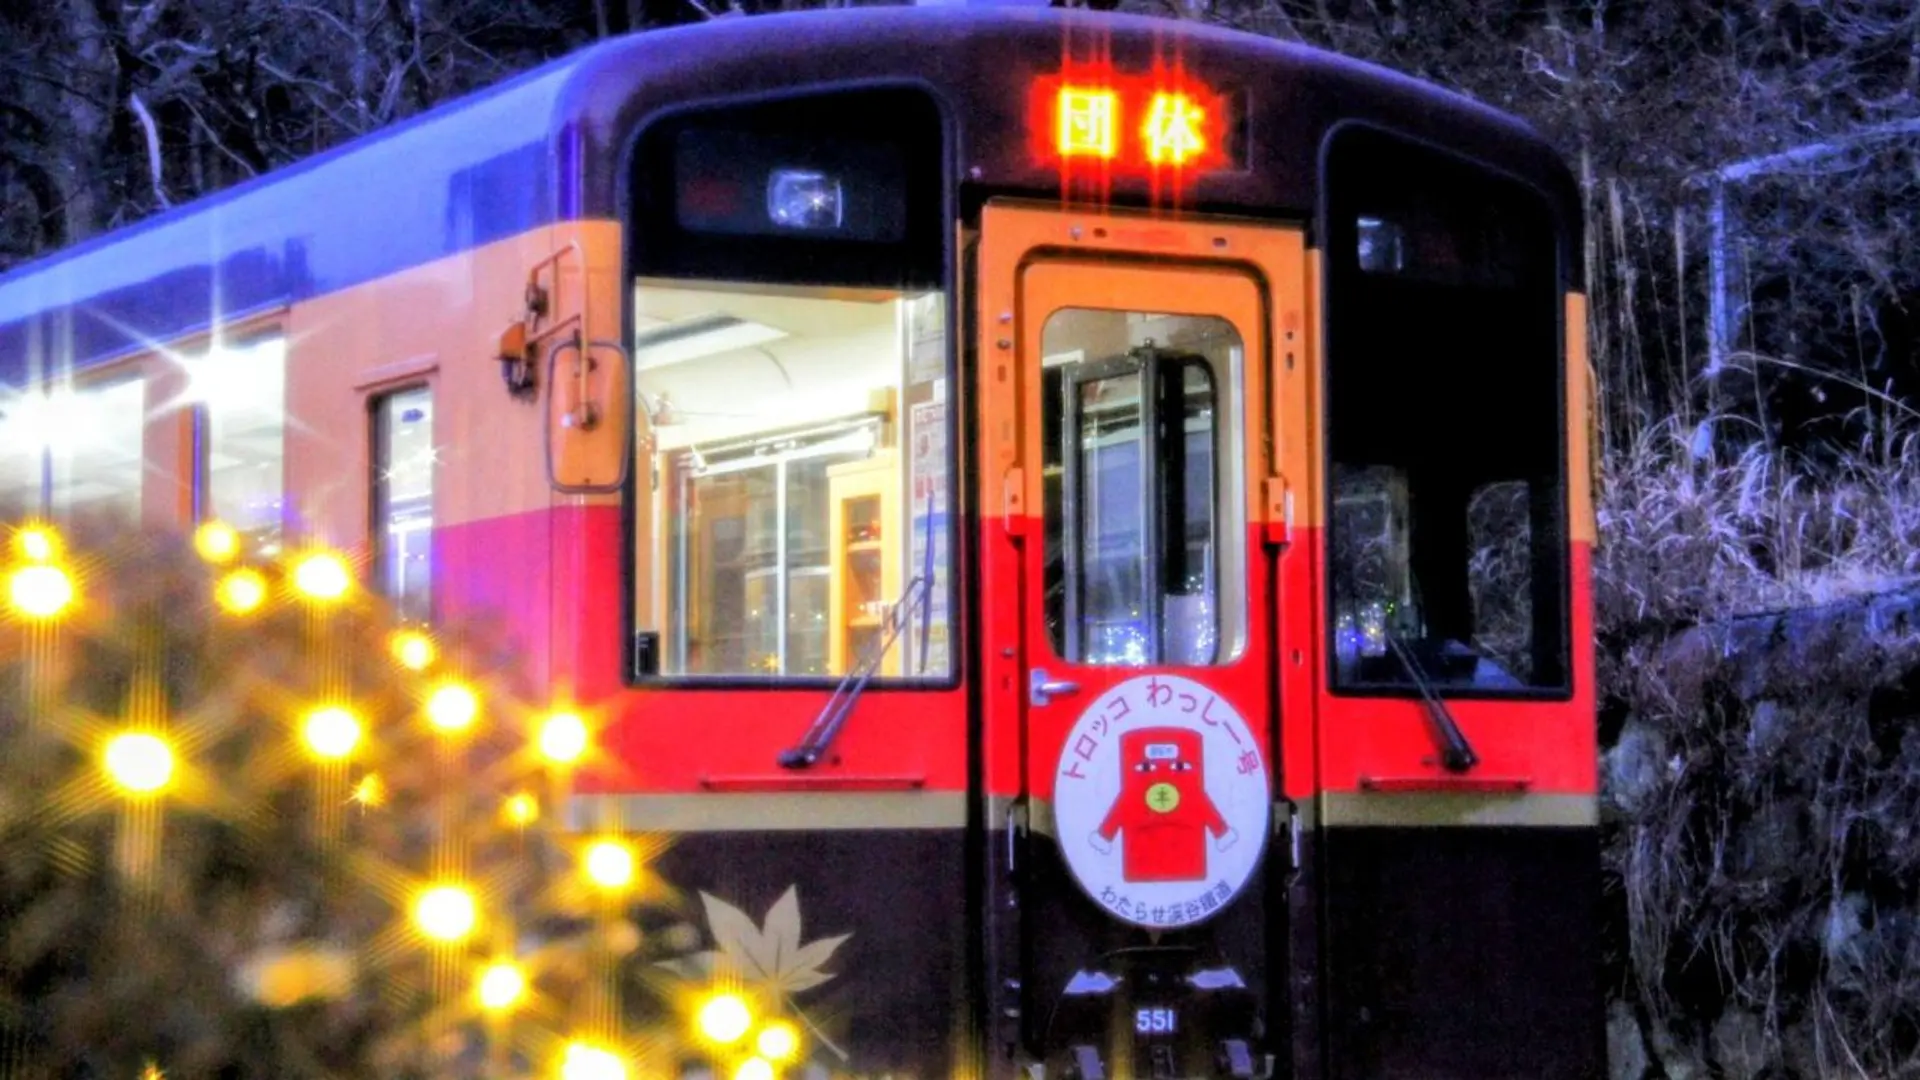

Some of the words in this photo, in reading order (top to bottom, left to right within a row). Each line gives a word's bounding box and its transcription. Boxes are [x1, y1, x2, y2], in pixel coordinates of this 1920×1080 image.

[1059, 88, 1206, 162] 団体
[1063, 695, 1130, 780] トロッコ
[1146, 677, 1259, 776] わっしー号
[1136, 1009, 1174, 1032] 551
